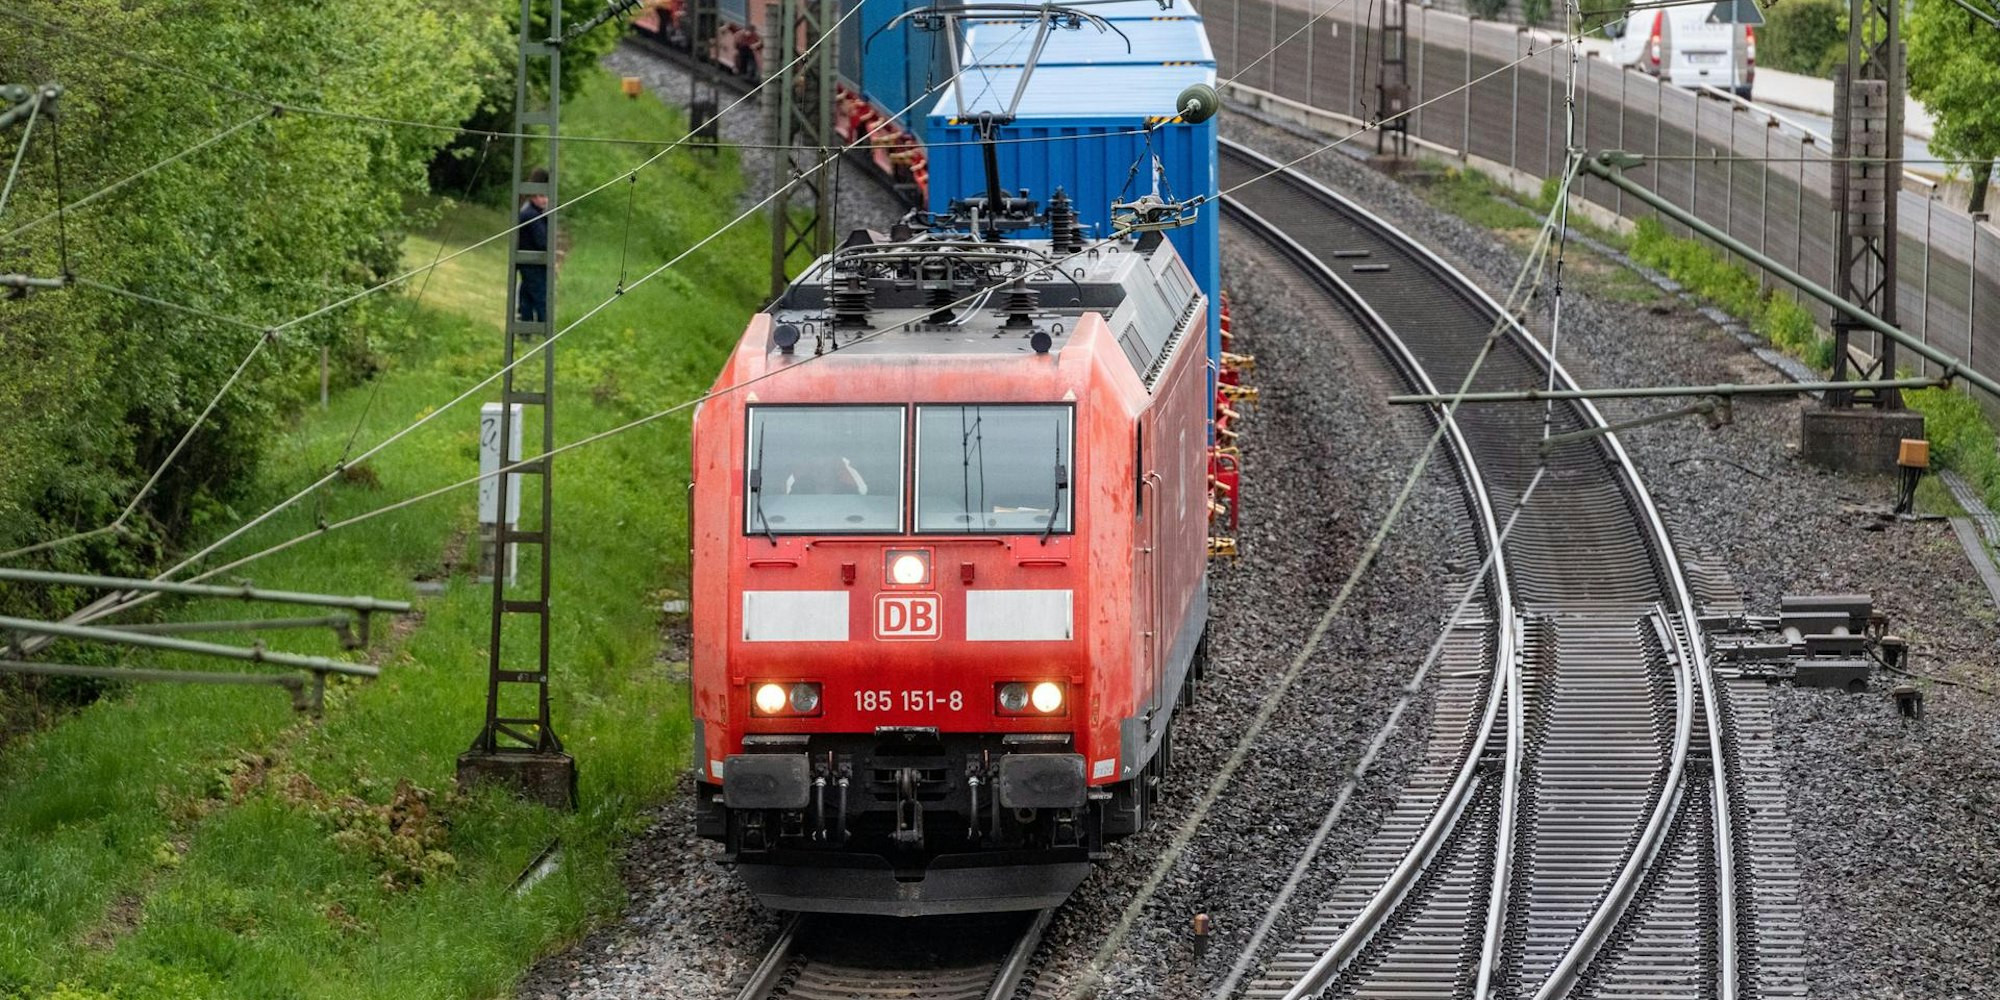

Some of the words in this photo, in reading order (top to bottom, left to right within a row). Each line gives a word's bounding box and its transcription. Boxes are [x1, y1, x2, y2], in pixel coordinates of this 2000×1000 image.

[883, 601, 933, 631] DB
[854, 690, 892, 711] 185
[901, 690, 963, 711] 151-8
